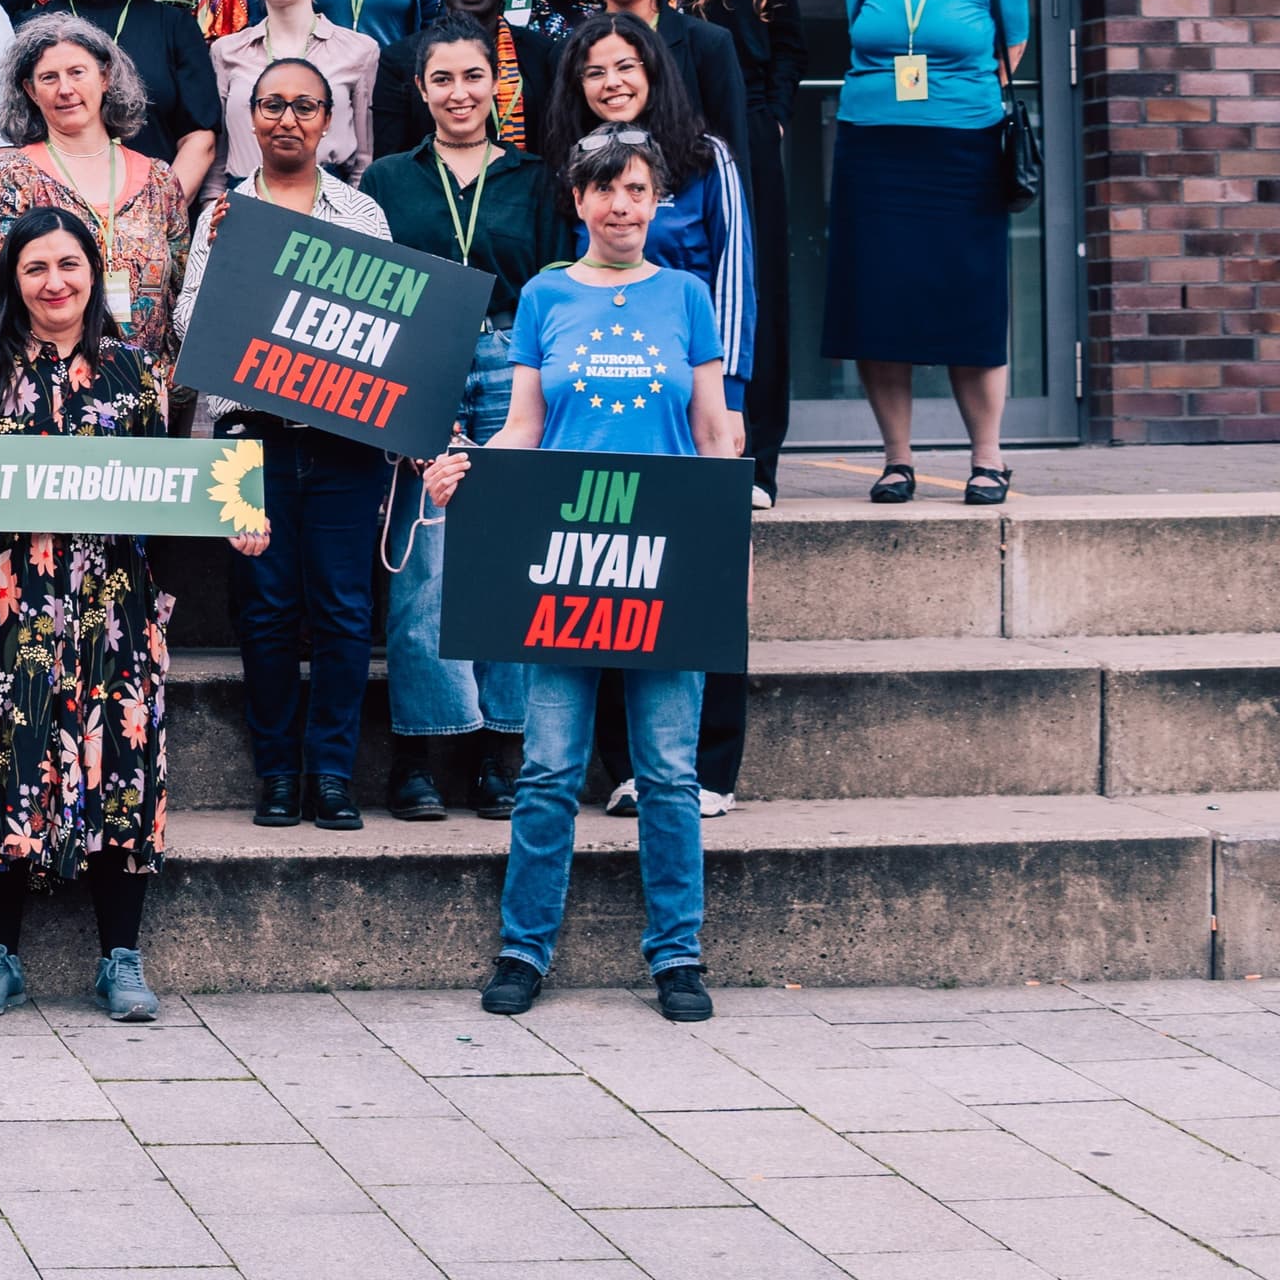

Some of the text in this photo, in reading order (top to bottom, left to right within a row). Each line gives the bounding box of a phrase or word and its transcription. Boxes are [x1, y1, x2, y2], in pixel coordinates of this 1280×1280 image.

[271, 230, 431, 317] FRAUEN
[271, 290, 401, 368] LEBEN
[232, 338, 408, 428] FREIHEIT
[585, 366, 652, 378] NAZIFREI
[590, 354, 645, 365] EUROPA
[25, 459, 199, 504] VERBÜNDET
[560, 469, 641, 524] JIN
[529, 531, 666, 589] JIYAN
[523, 594, 664, 653] AZADI
